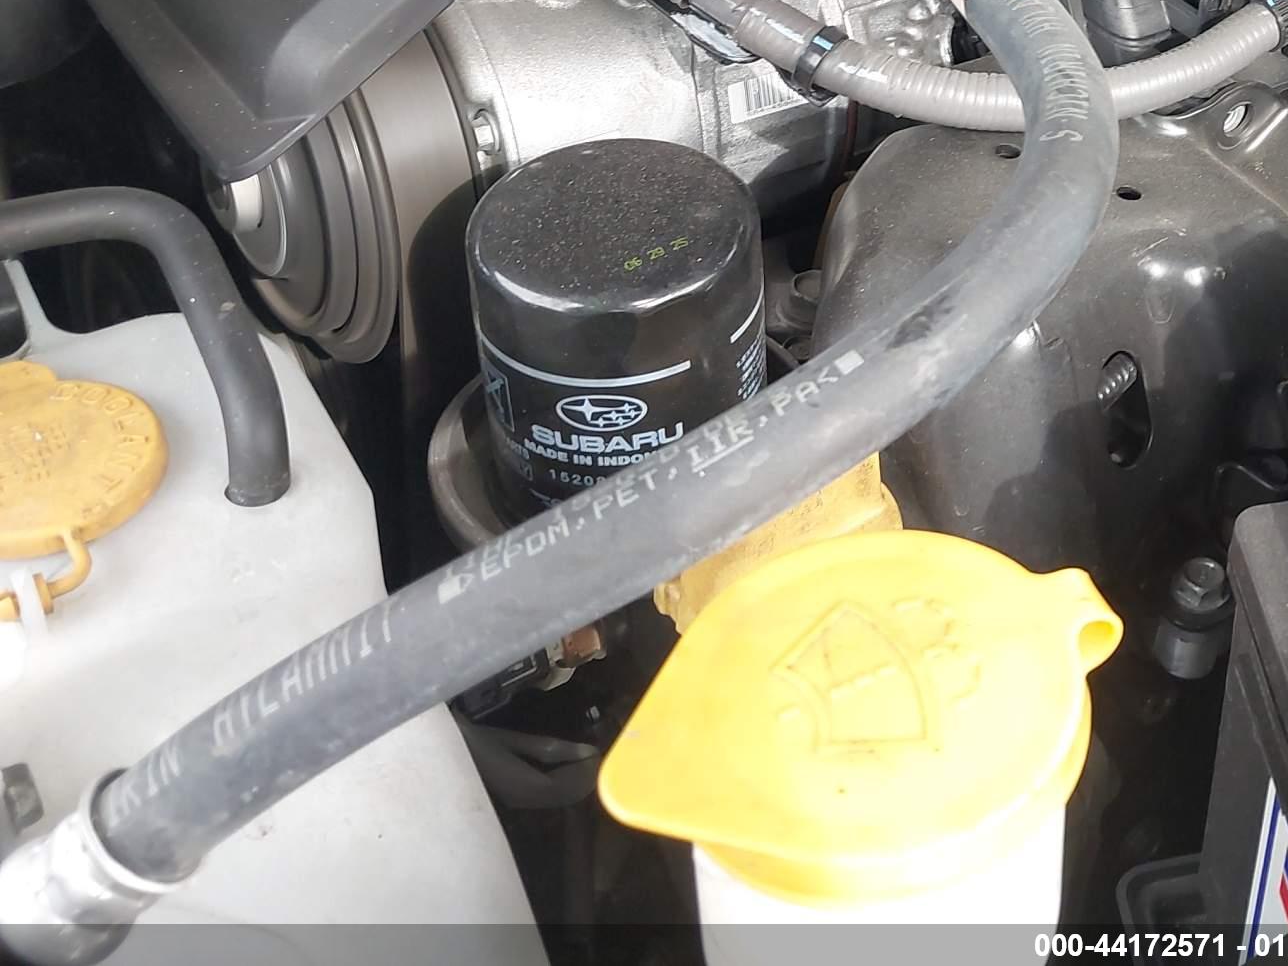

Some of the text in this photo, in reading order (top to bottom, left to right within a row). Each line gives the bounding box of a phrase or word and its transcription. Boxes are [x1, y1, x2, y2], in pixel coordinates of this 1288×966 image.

[523, 437, 569, 463] MADE
[573, 454, 593, 466] IN
[531, 421, 684, 454] SUBARU
